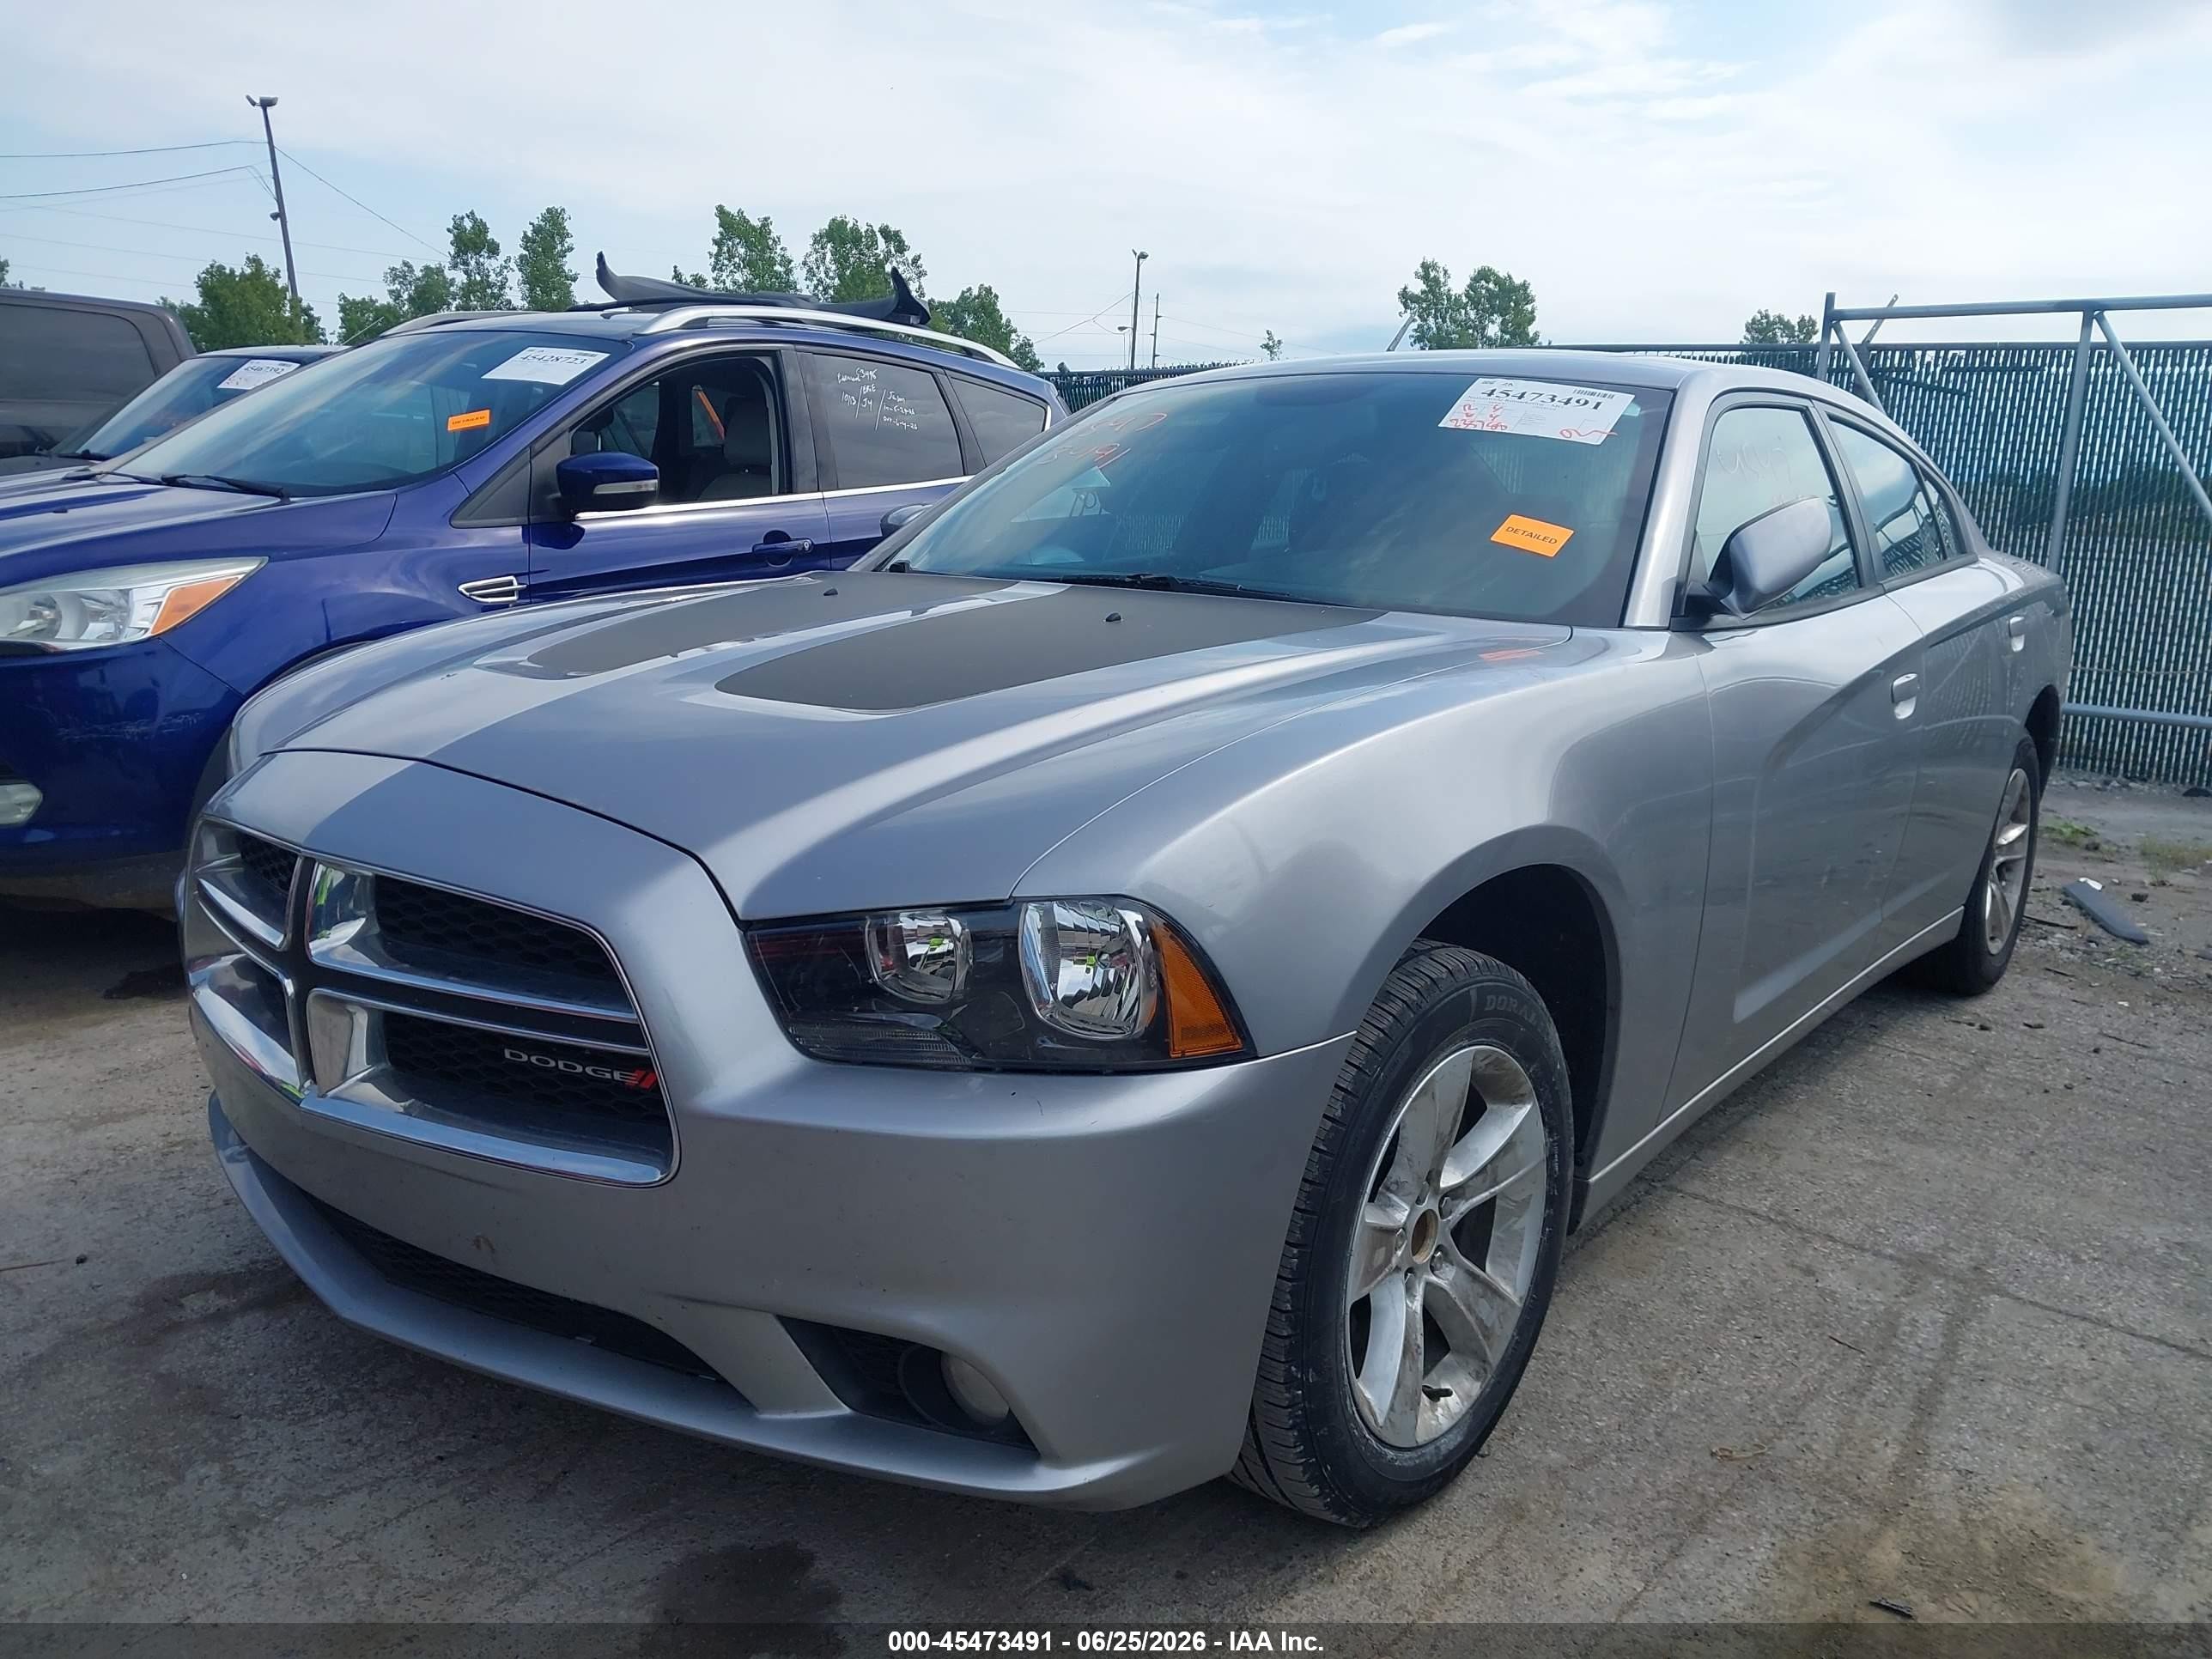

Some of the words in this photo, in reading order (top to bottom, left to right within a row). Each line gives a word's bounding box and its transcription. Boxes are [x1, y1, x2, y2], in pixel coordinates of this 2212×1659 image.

[1480, 387, 1604, 410] 45473491
[1505, 526, 1558, 544] DETAILED
[503, 1048, 639, 1085] DODGE
